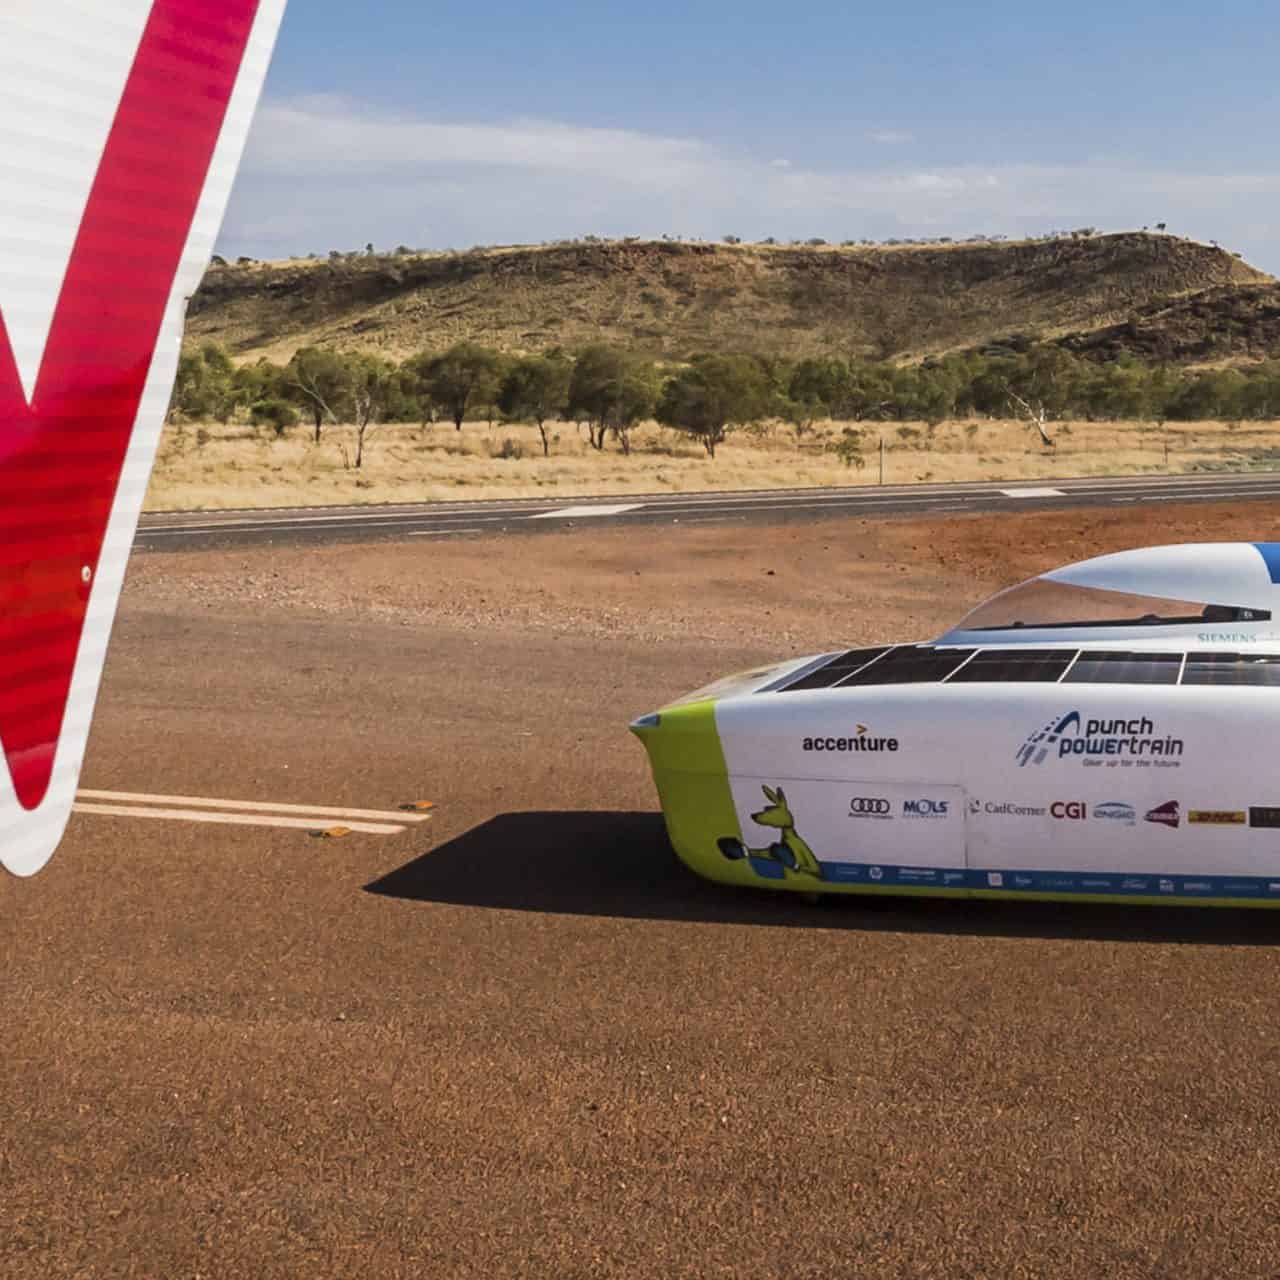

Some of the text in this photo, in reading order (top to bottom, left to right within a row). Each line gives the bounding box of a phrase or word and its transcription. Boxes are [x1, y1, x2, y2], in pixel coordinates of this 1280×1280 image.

[1086, 715, 1154, 738] punch
[802, 734, 899, 752] accenture
[1136, 758, 1151, 767] the
[984, 801, 1046, 817] CadCorner
[1050, 801, 1087, 820] CGI
